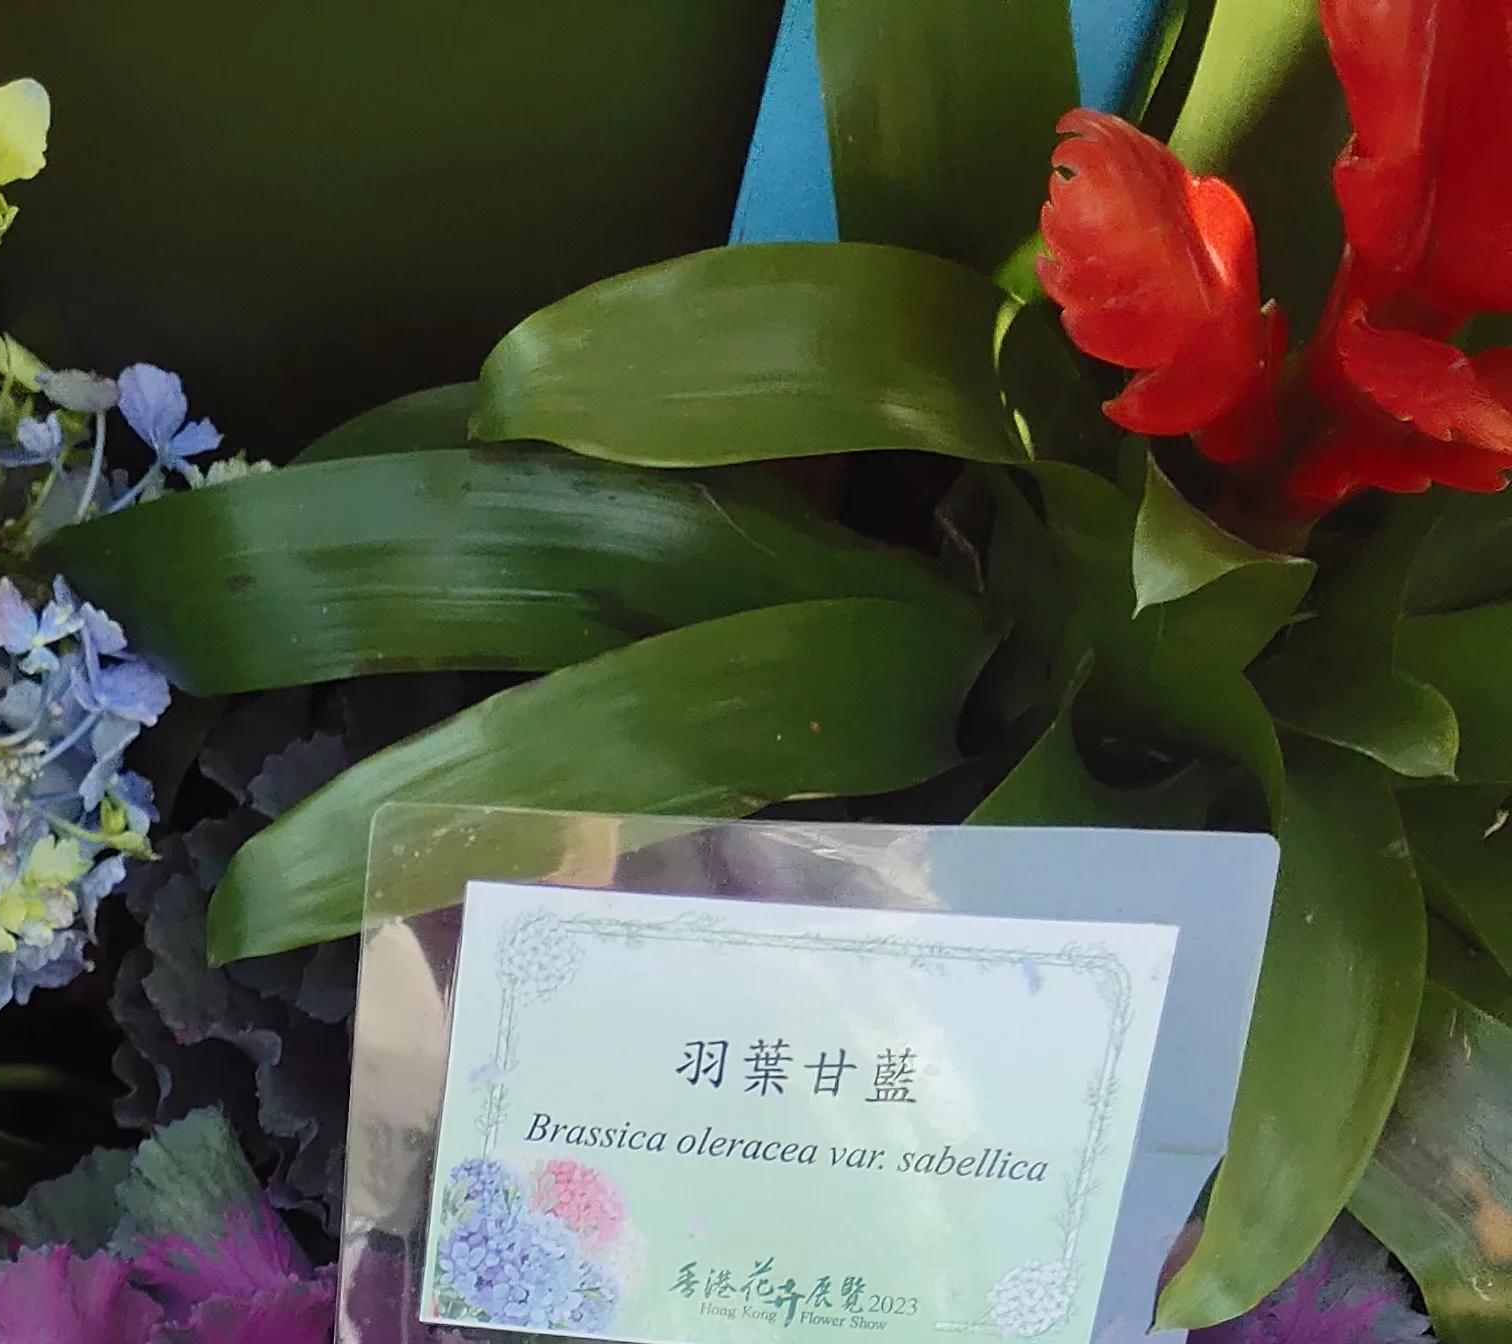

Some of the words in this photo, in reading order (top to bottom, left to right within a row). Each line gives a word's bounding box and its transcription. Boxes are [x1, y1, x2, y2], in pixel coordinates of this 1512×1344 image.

[674, 1037, 918, 1104] 羽葉甘藍
[523, 1112, 668, 1152] Brassica
[676, 1126, 819, 1165] oleracea
[829, 1146, 885, 1171] var.
[896, 1145, 1049, 1183] sabellica
[699, 1301, 737, 1320] Hong
[741, 1304, 778, 1325] Kong
[799, 1310, 847, 1329] Flower
[849, 1315, 888, 1332] Show
